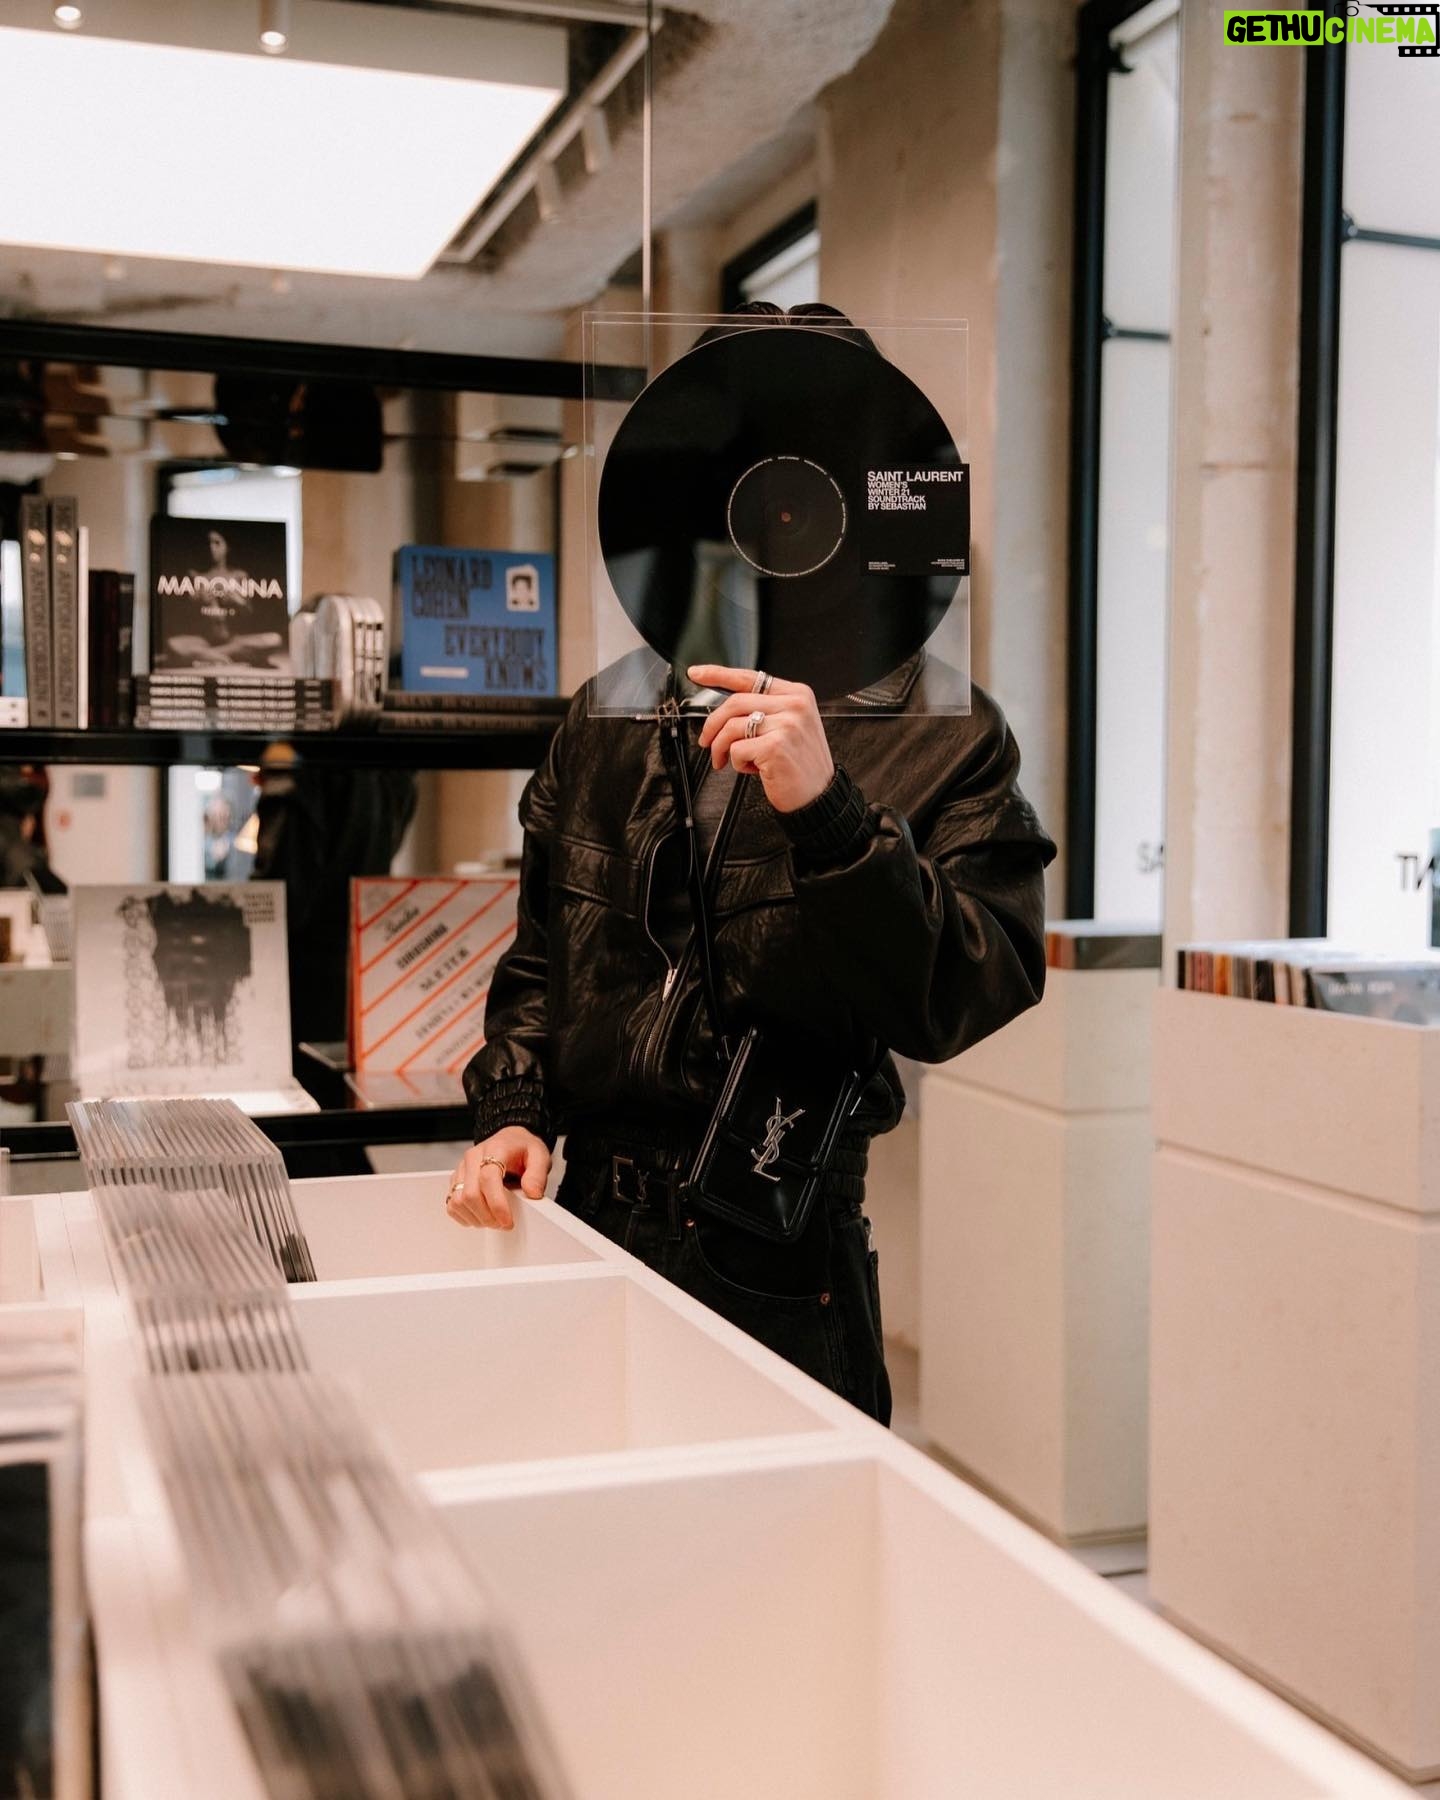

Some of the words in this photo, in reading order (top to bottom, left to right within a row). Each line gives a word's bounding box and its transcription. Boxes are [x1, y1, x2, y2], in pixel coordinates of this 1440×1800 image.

[867, 471, 903, 482] SAINT
[906, 471, 964, 482] LAURENT
[867, 481, 908, 489] WOMEN'S
[867, 488, 900, 496] WINTER
[901, 488, 910, 496] 21
[867, 495, 926, 503] SOUNDTRACK
[867, 502, 879, 510] BY
[880, 502, 926, 510] SEBASTIAN
[411, 555, 492, 590] LEONARD
[157, 575, 284, 600] MADONNA
[412, 588, 469, 620] COHEN
[444, 624, 545, 660] EVERYBODY
[485, 657, 547, 690] KNOWS
